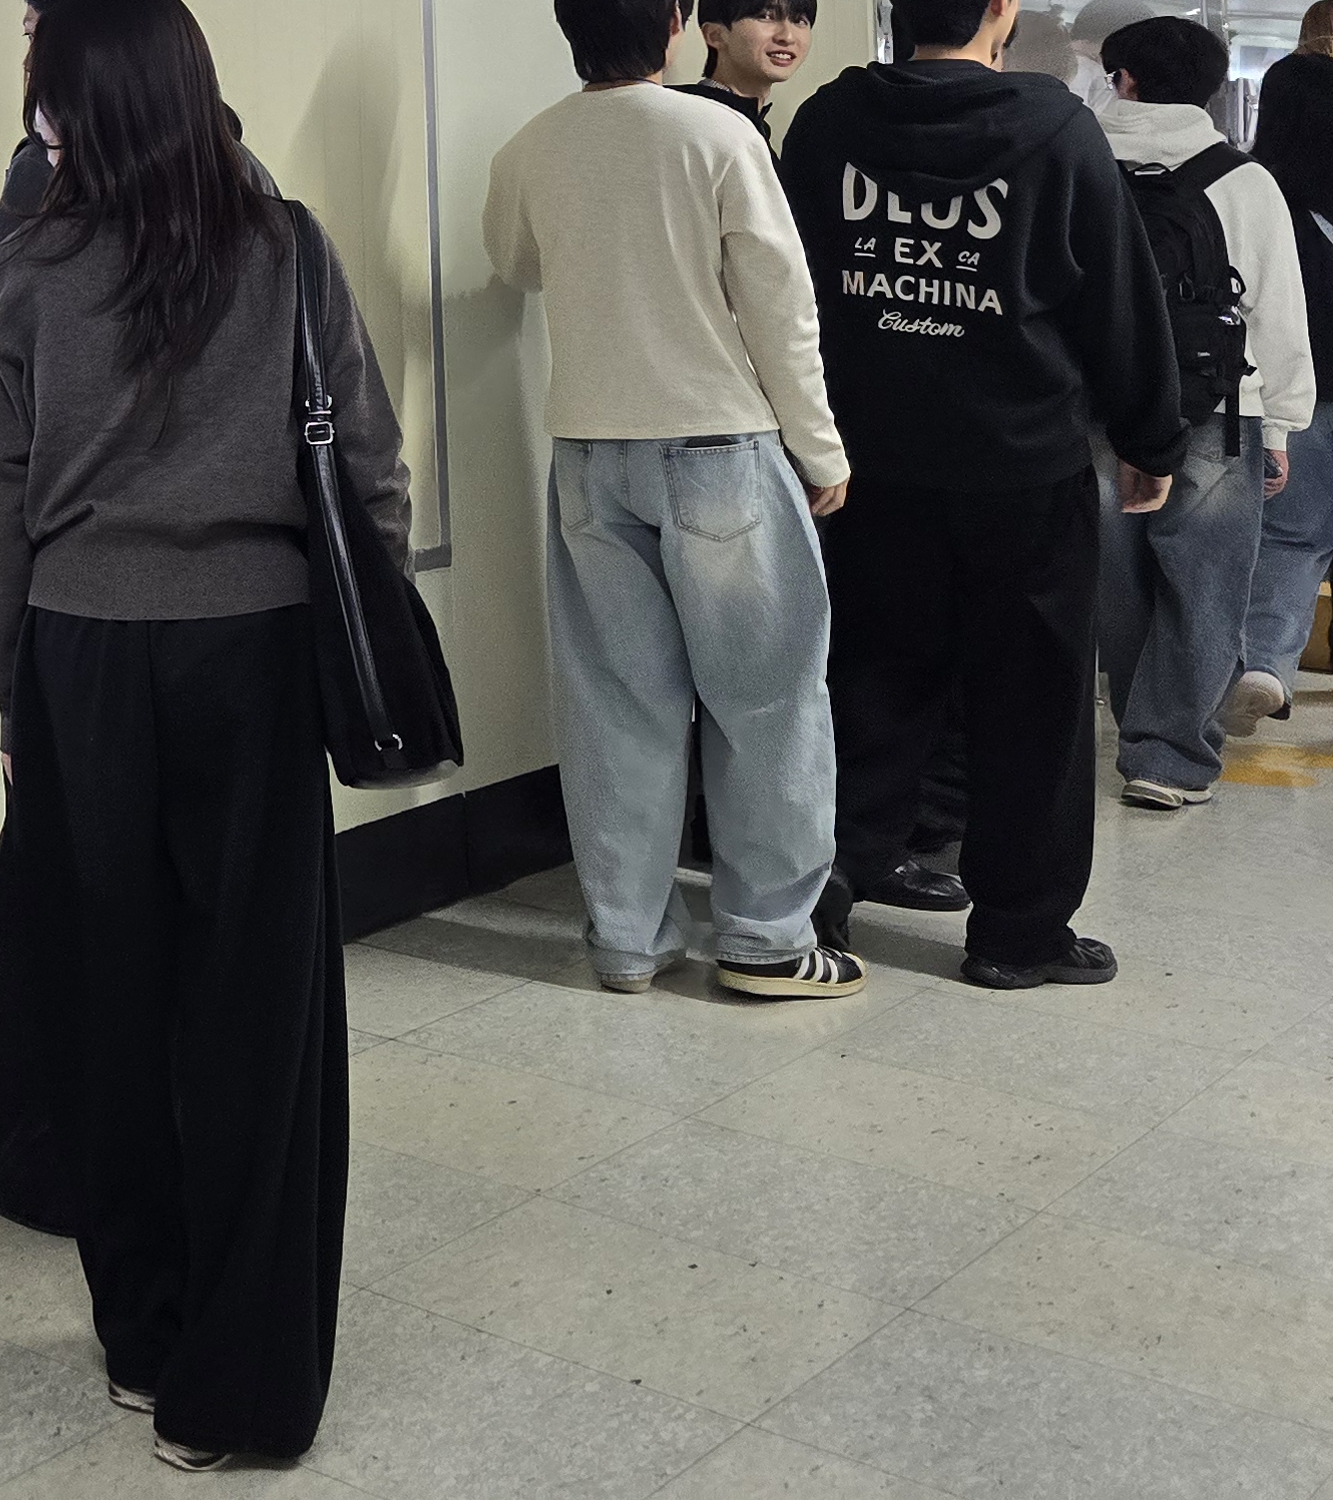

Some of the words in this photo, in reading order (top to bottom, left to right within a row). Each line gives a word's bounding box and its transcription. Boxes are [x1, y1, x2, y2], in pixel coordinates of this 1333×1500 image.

[854, 237, 877, 251] LA
[894, 237, 943, 268] EX
[957, 250, 981, 266] CA
[842, 269, 1003, 316] MACHINA
[878, 309, 965, 337] Custom
